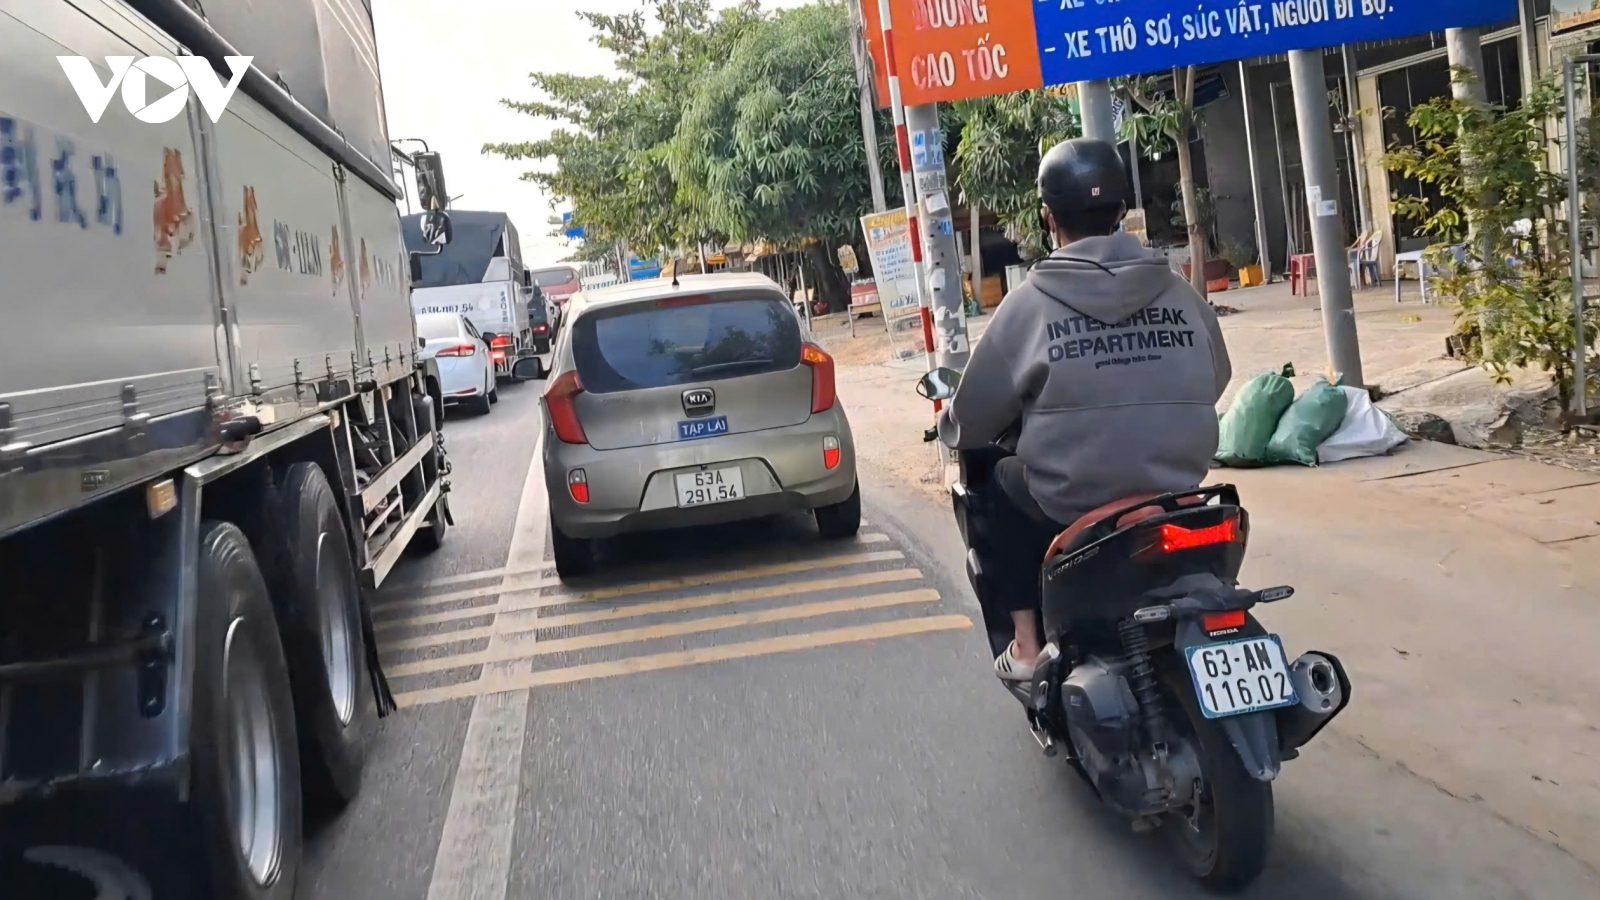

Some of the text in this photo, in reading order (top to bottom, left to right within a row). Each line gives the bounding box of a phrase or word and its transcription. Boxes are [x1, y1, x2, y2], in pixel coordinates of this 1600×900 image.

[1063, 30, 1092, 59] XE
[1095, 16, 1137, 54] THÔ
[1145, 14, 1179, 49] SƠ,
[1182, 5, 1222, 41] SÚC
[911, 33, 1009, 91] CAO TỐC
[1048, 330, 1195, 363] DEPARTMENT
[689, 393, 709, 404] KIA
[685, 484, 737, 504] 291.54
[695, 470, 724, 487] 63A
[1209, 627, 1240, 638] HONDA
[1202, 641, 1272, 678] 63-AN
[1205, 672, 1285, 711] 116.02
